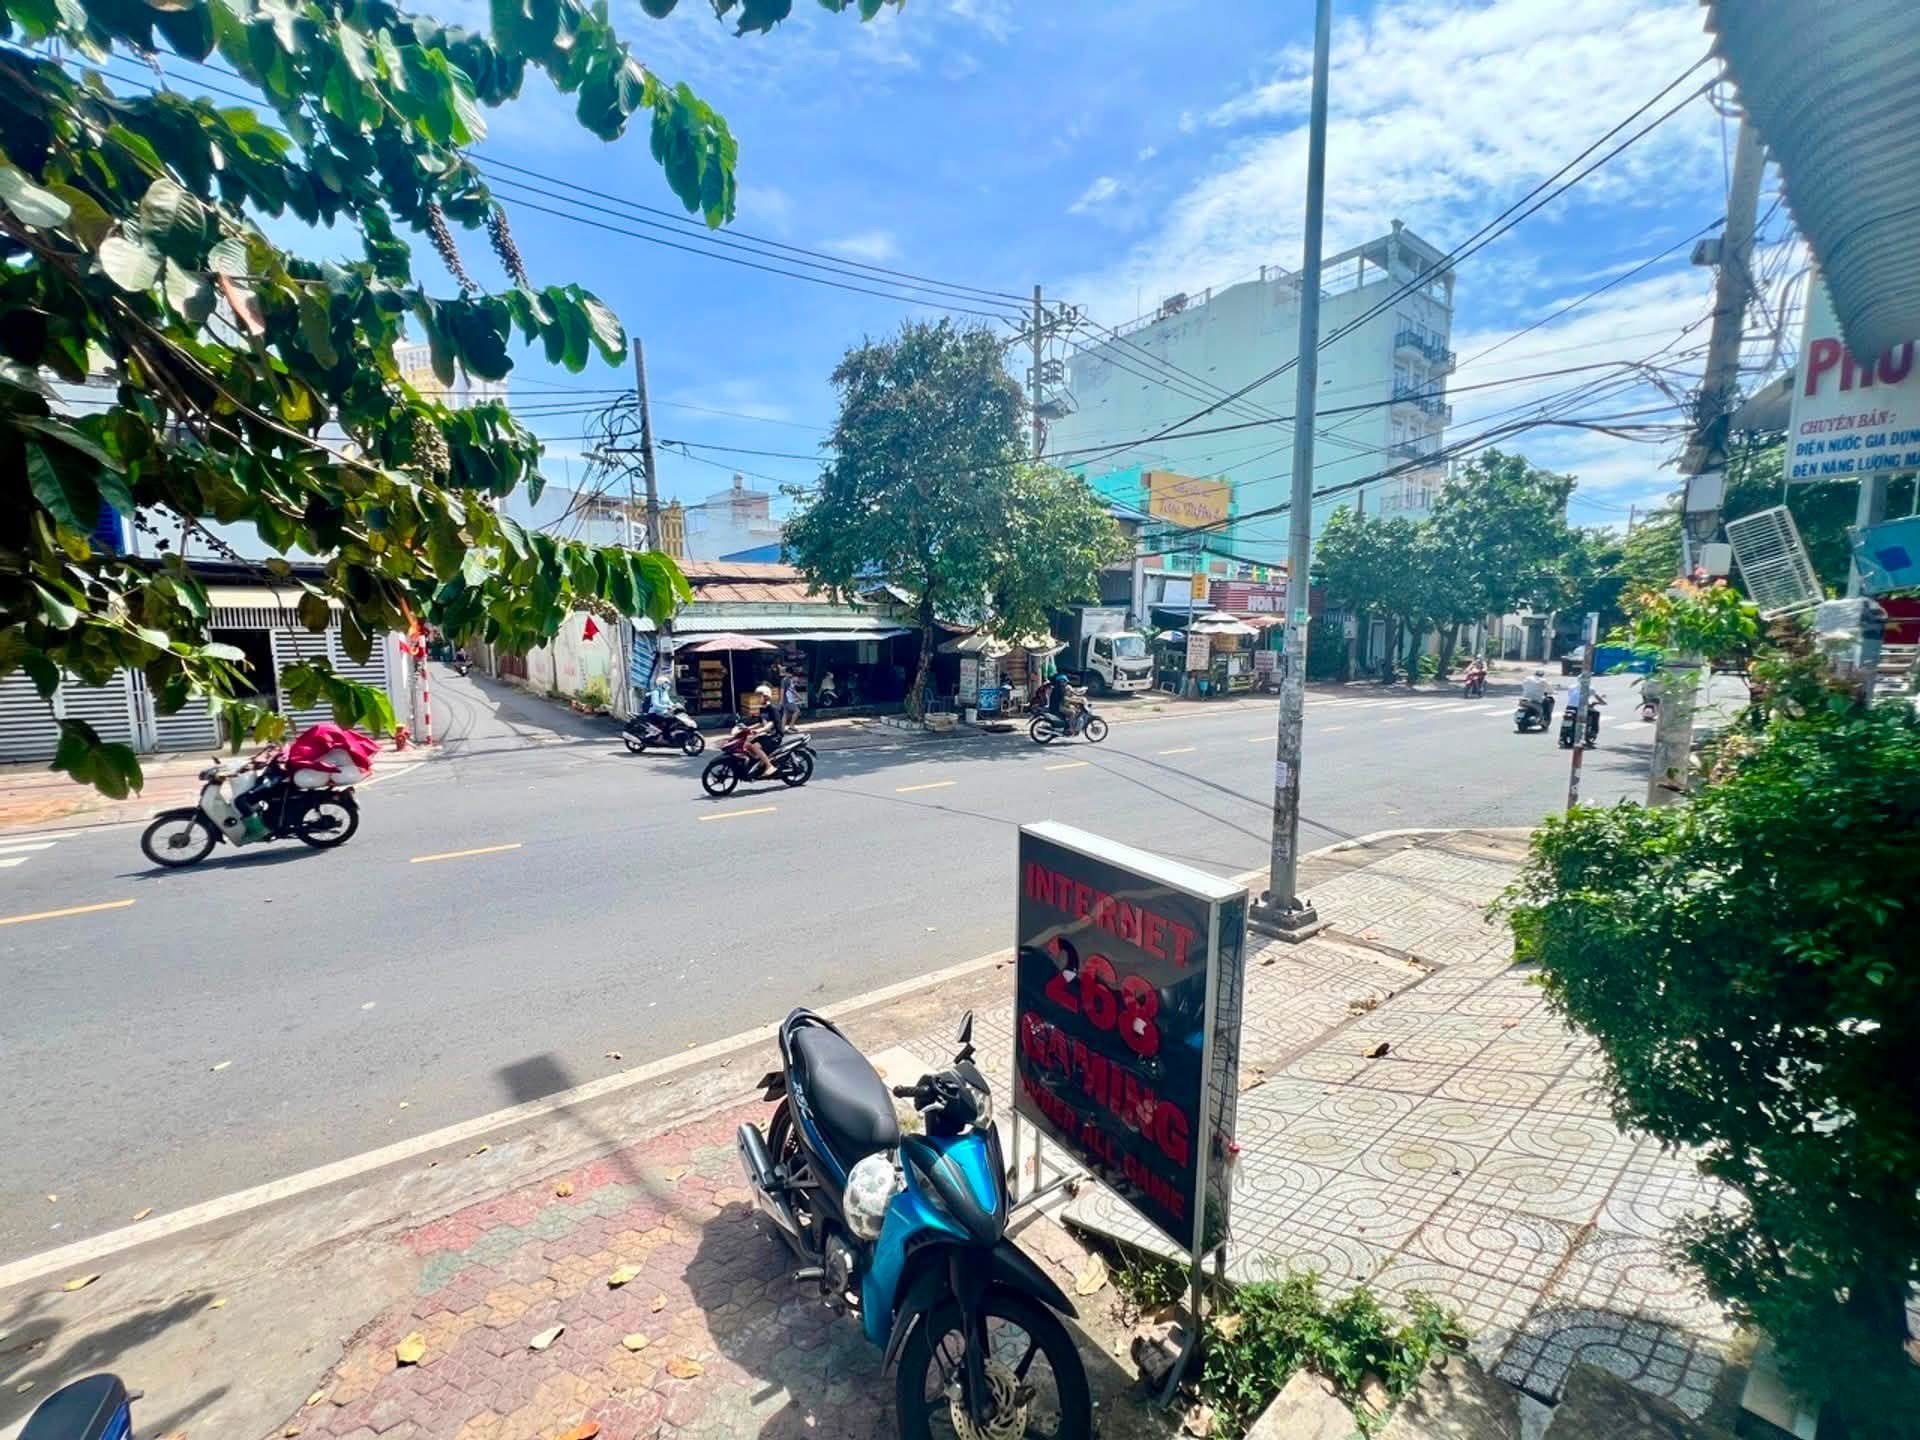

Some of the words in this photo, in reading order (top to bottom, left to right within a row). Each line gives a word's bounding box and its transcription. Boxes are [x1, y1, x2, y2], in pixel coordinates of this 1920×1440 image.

[1026, 862, 1197, 969] INTERNET
[1045, 936, 1160, 1058] 268
[1021, 1010, 1190, 1169] GAMING
